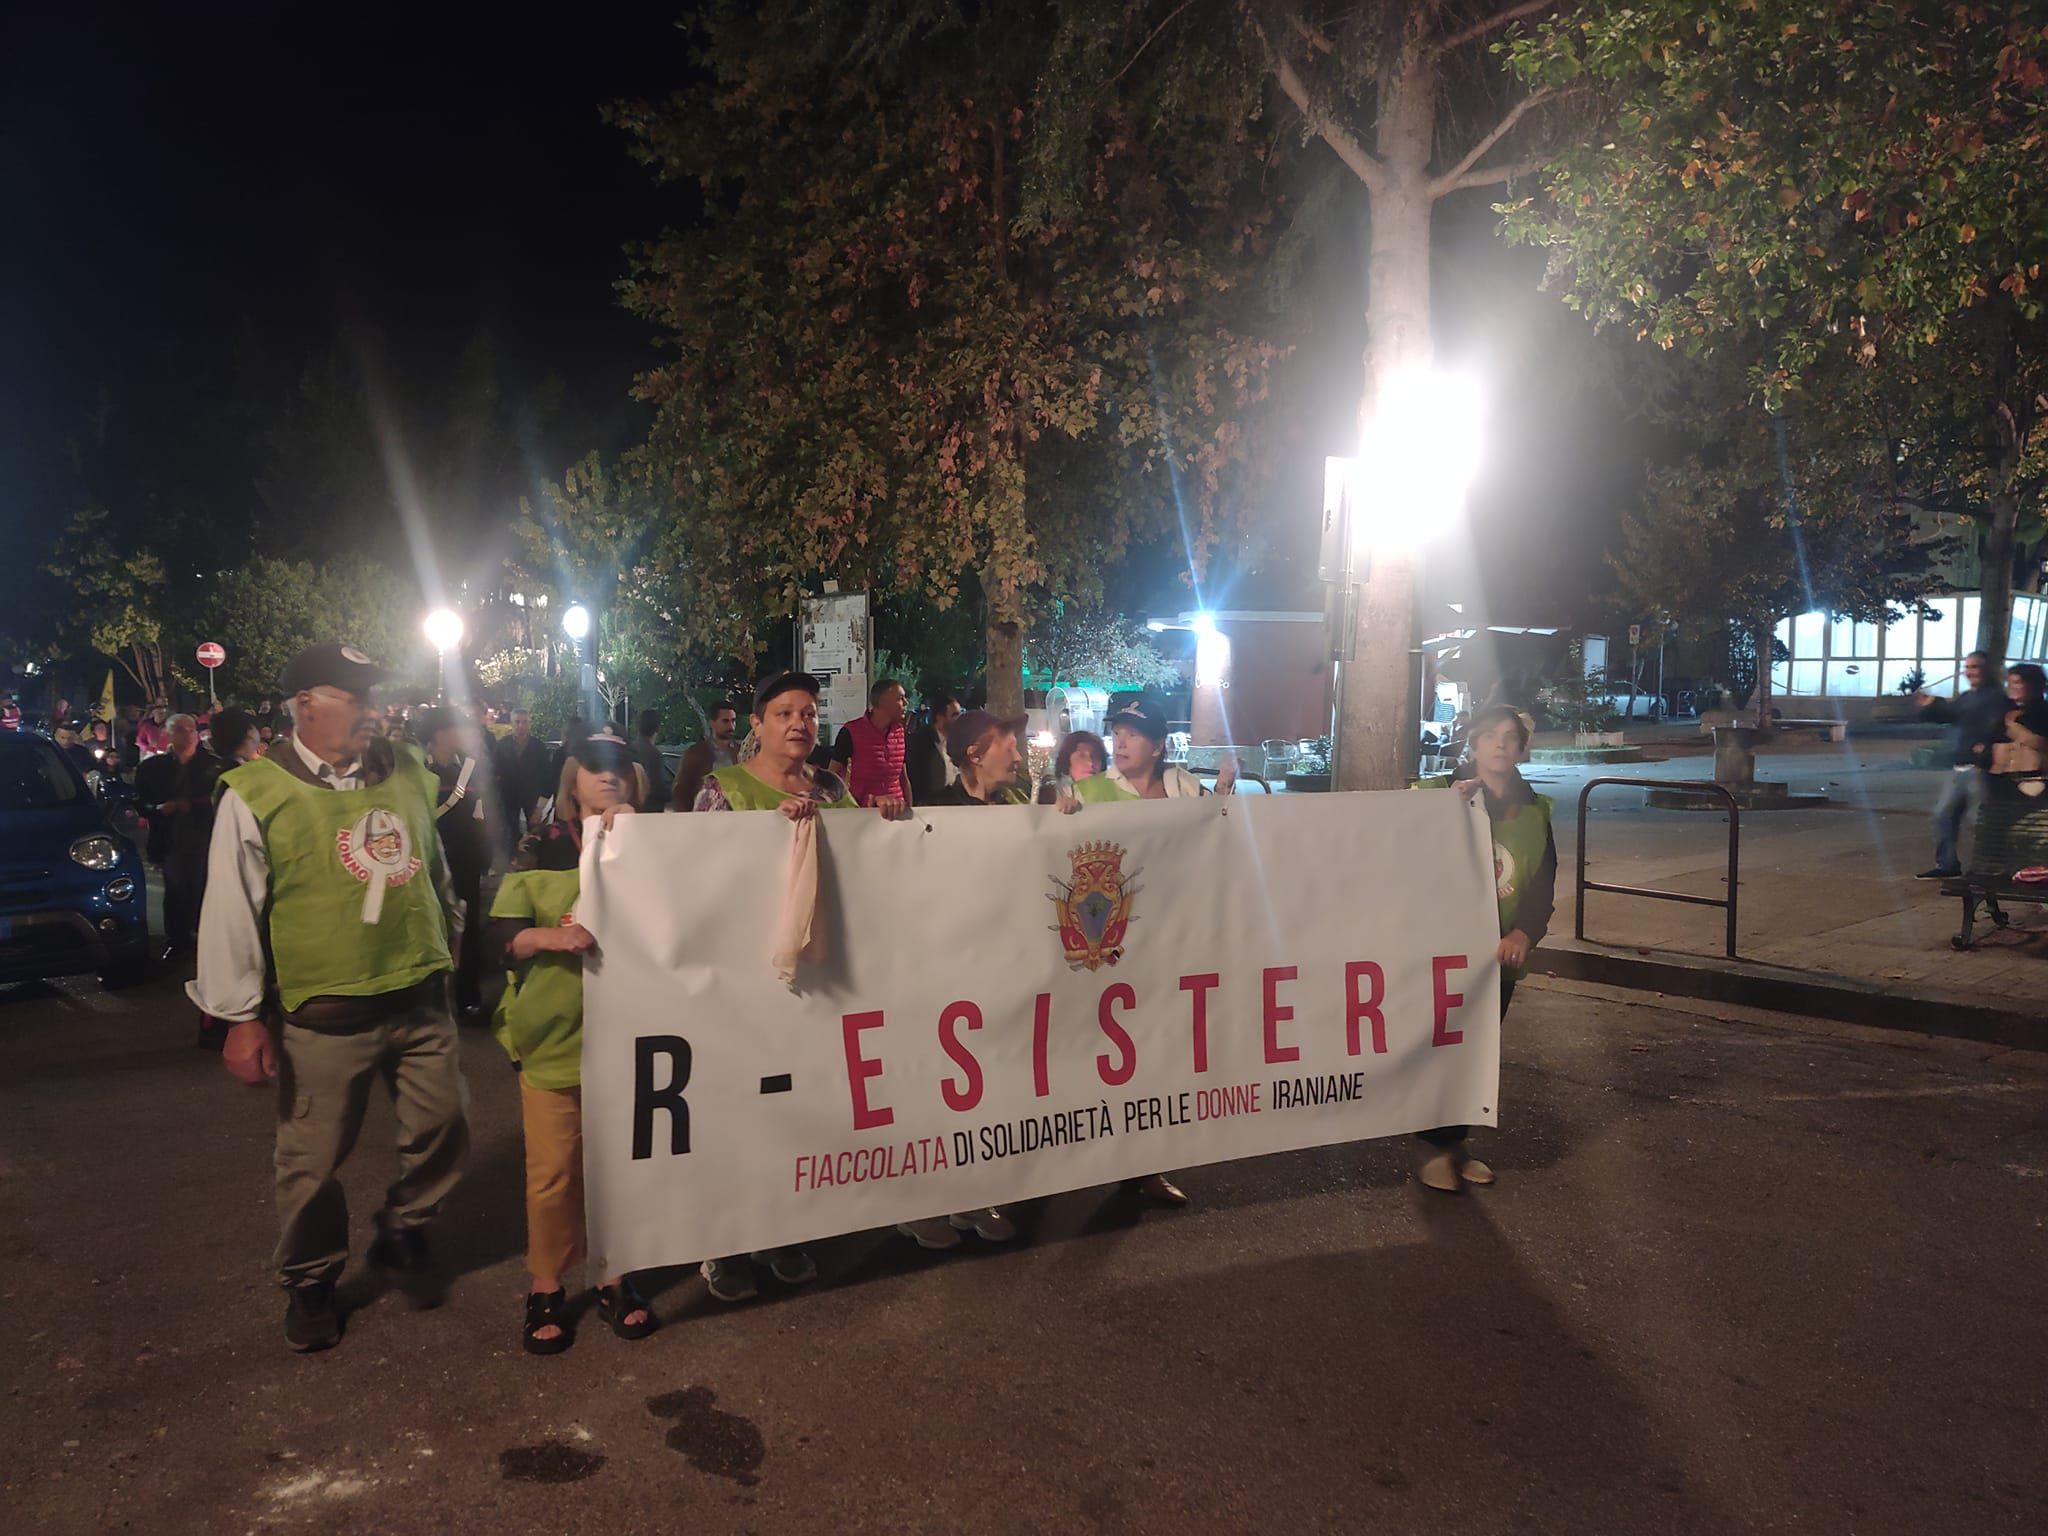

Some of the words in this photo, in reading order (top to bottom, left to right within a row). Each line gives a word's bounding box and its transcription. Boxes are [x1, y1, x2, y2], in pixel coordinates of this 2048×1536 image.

[336, 828, 370, 881] NONNO
[794, 1136, 948, 1192] FIACCOLATA
[953, 1130, 974, 1167] DI
[981, 1100, 1114, 1161] SOLIDARIETÀ
[1124, 1096, 1162, 1133] PER
[1167, 1092, 1192, 1126] LE
[1197, 1083, 1261, 1121] DONNE
[1272, 1072, 1365, 1110] IRANIANE
